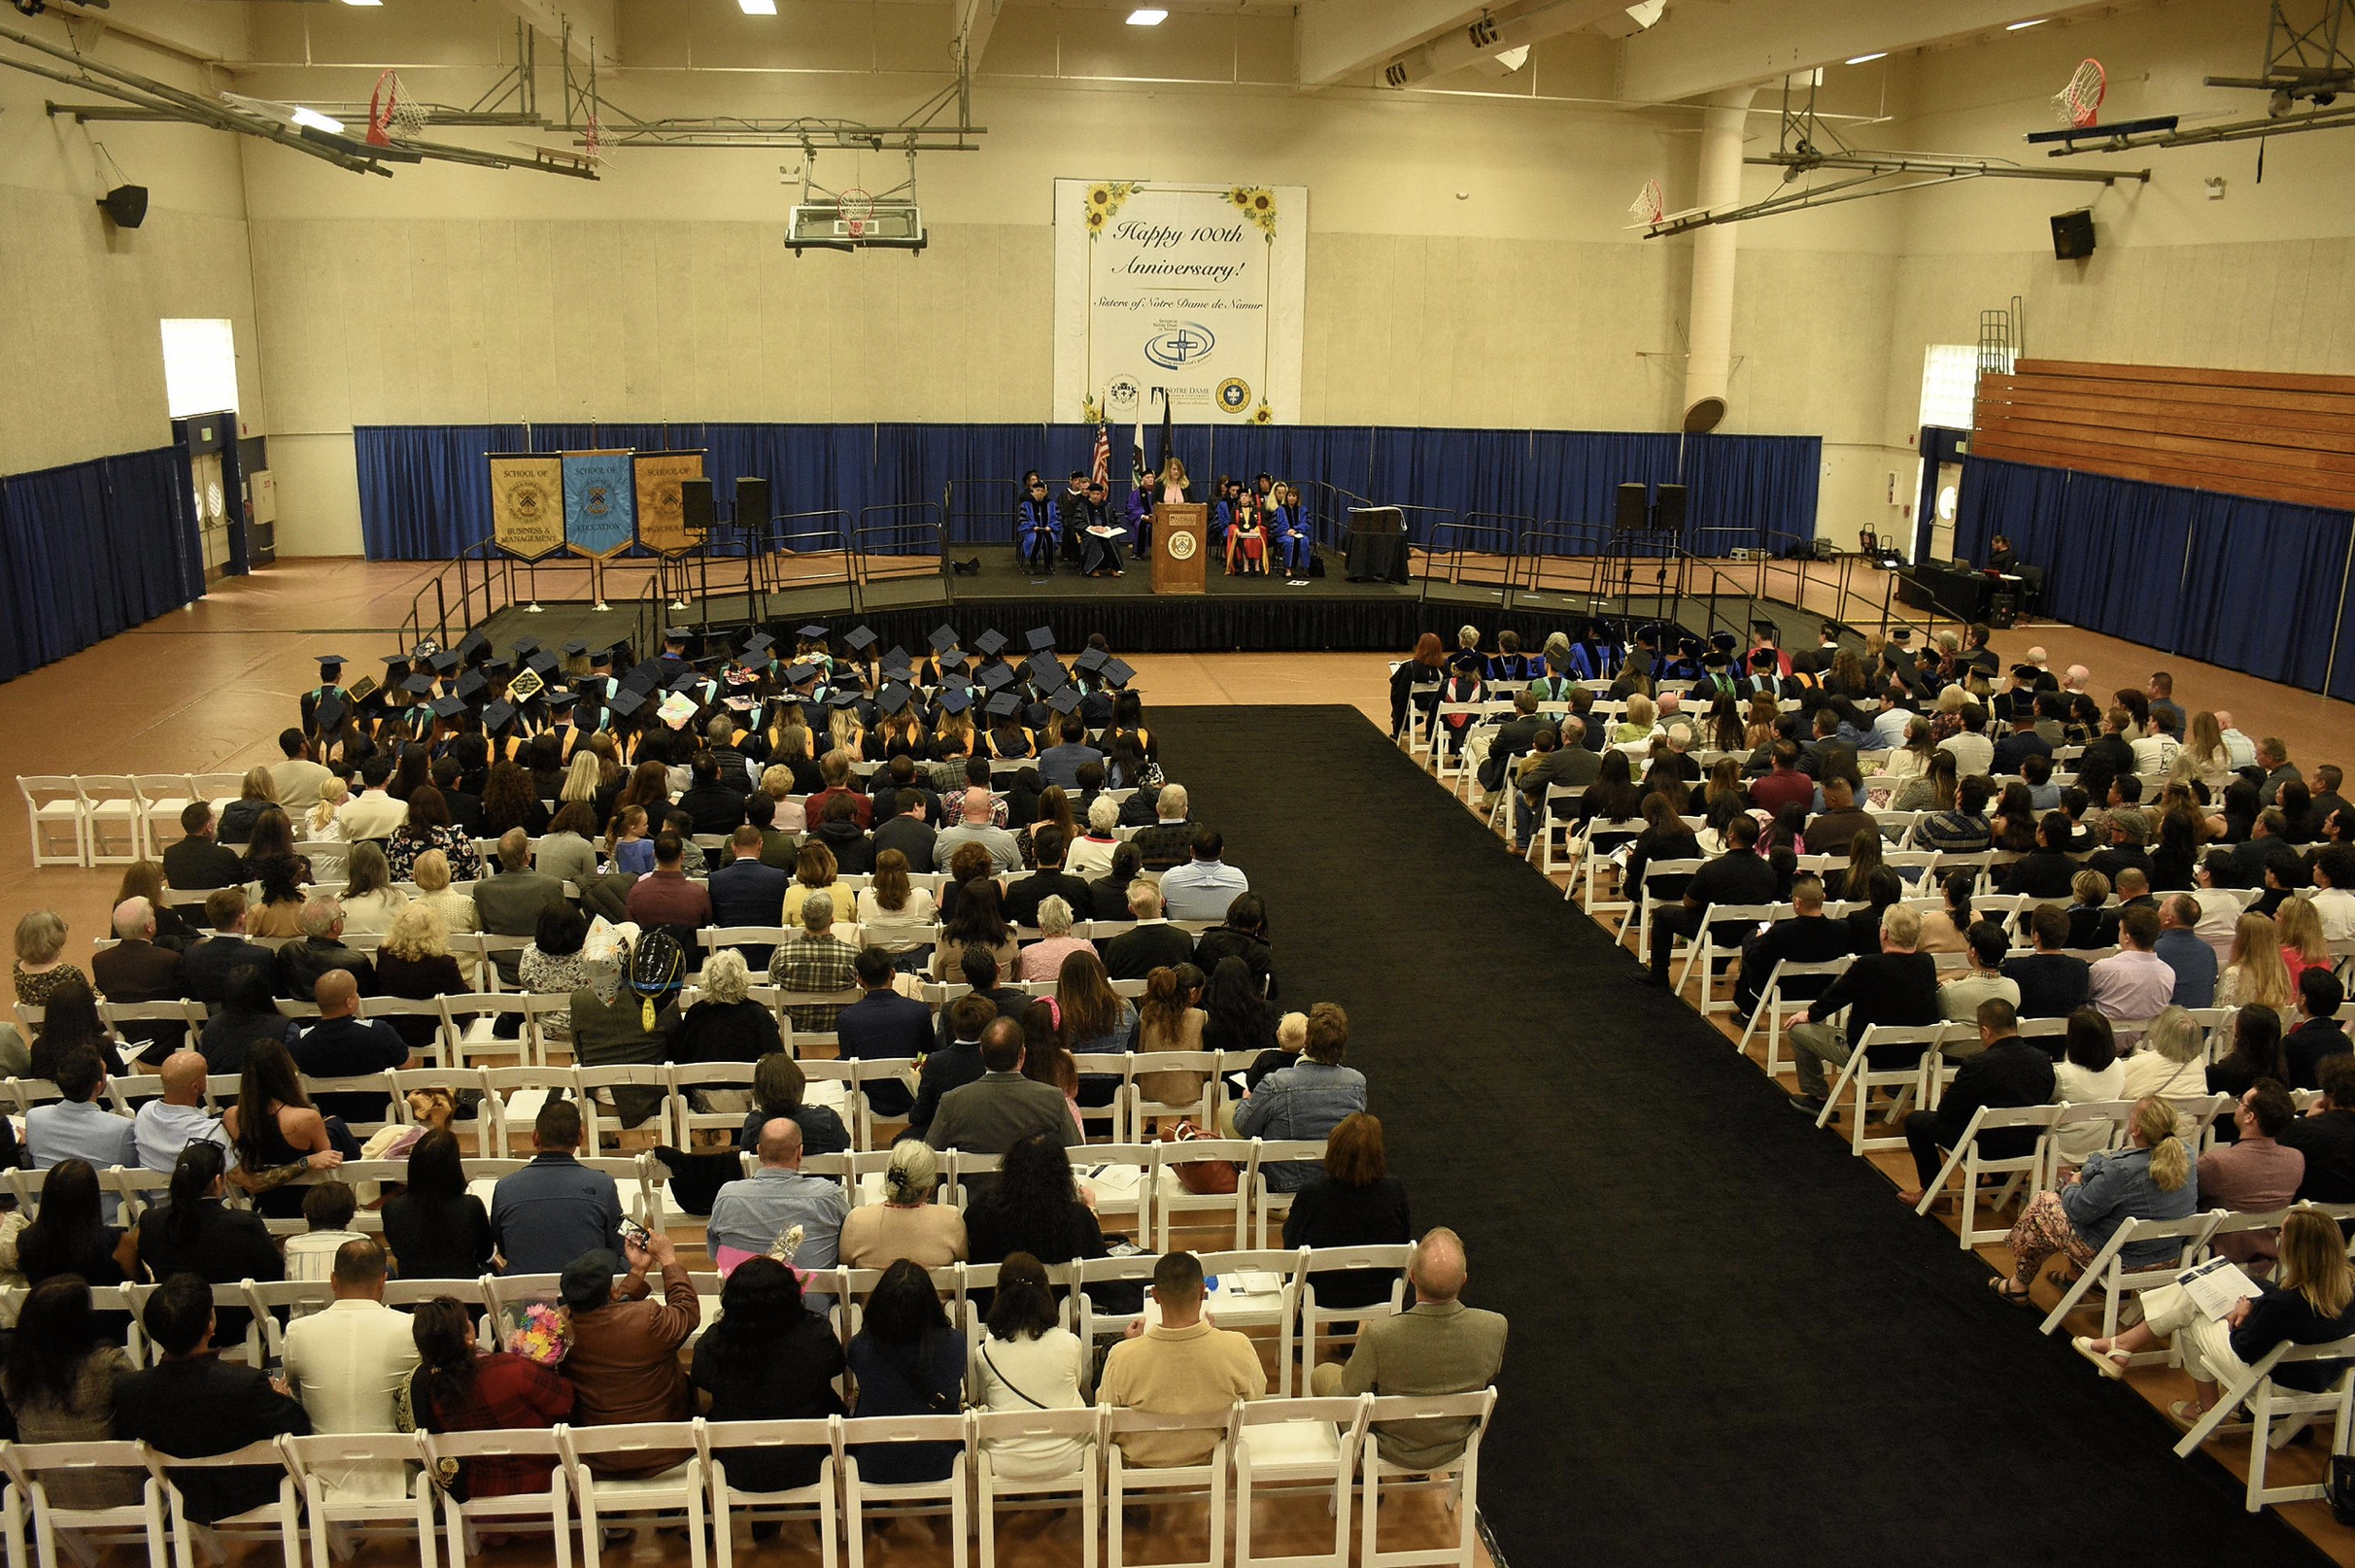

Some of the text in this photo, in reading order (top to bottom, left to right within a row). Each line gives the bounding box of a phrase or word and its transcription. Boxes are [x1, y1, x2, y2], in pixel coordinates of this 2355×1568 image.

[1112, 221, 1246, 249] Happy 100th
[1111, 255, 1246, 283] Anniversary!
[1093, 296, 1263, 311] Sisters of Notre Dame de Namur
[1219, 400, 1247, 411] BELMONT
[503, 469, 548, 478] SCHOOL OF
[575, 467, 605, 476] SCHOOL
[647, 467, 678, 477] SCHOOL
[577, 523, 621, 532] EDUCATION
